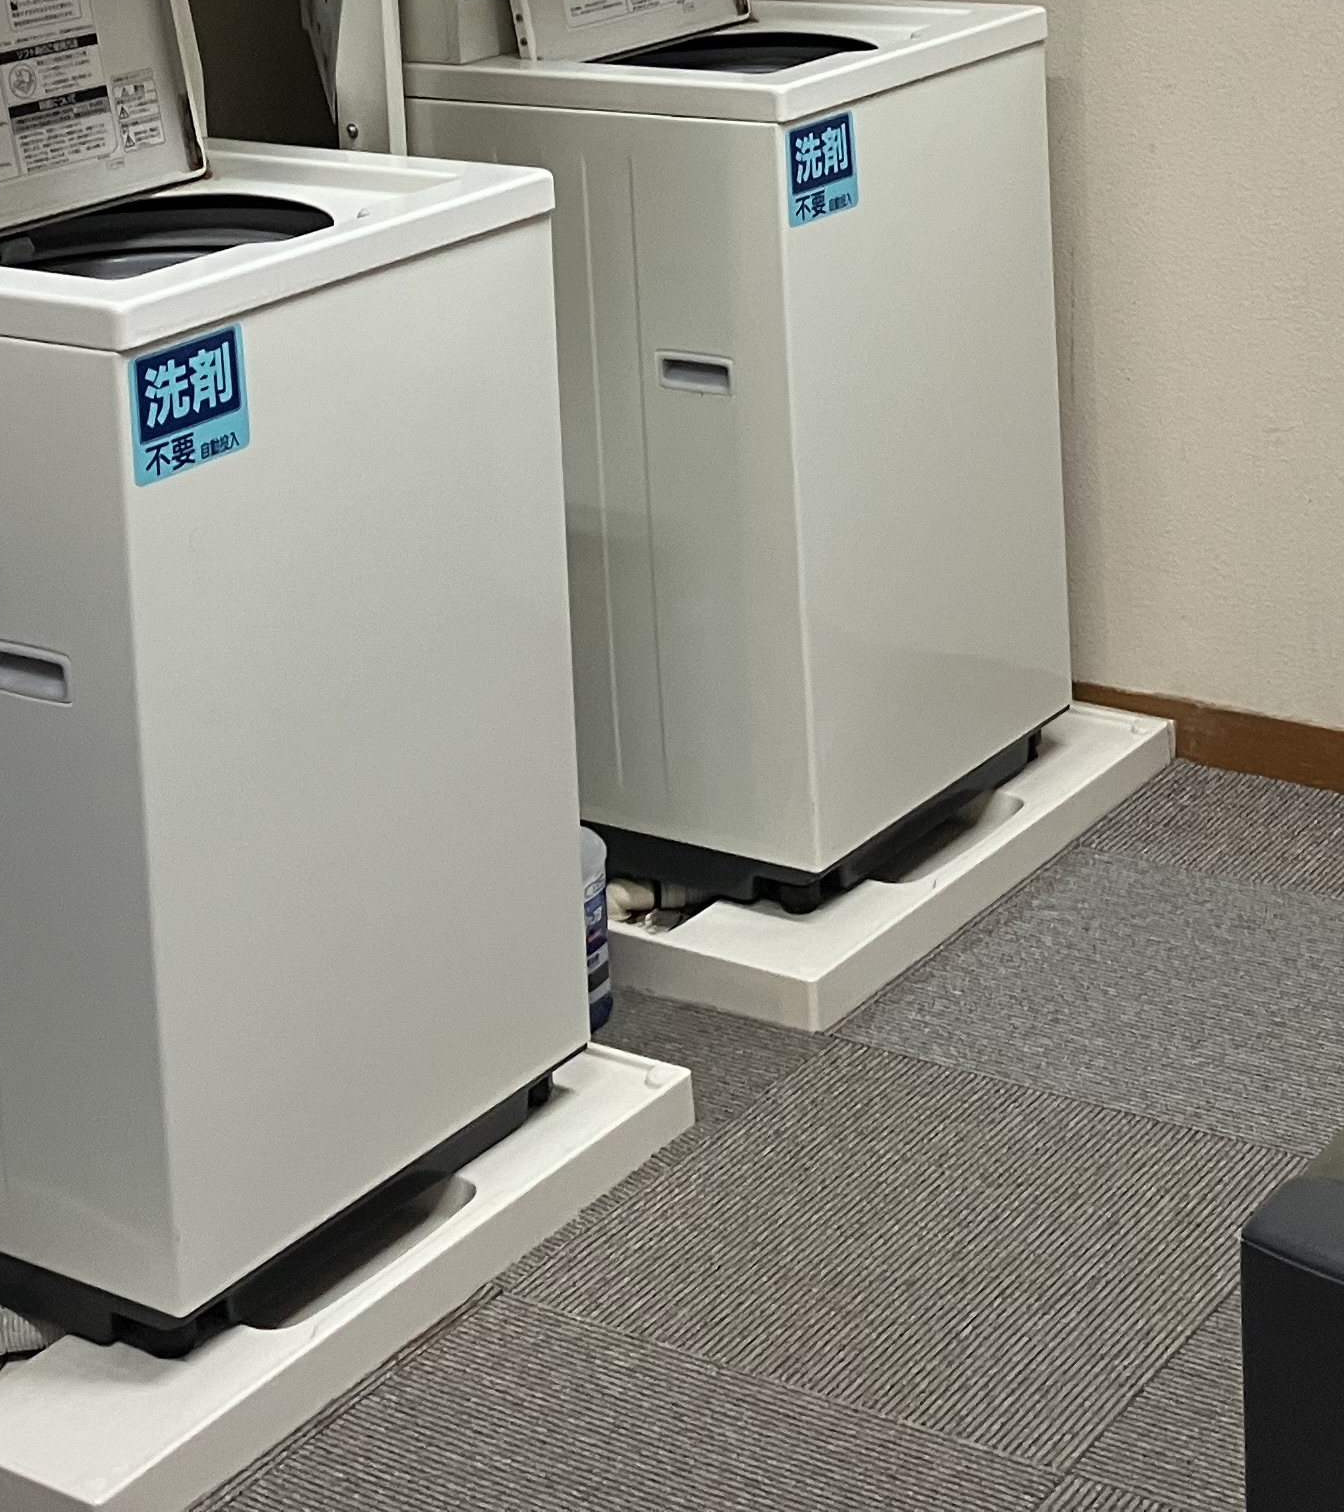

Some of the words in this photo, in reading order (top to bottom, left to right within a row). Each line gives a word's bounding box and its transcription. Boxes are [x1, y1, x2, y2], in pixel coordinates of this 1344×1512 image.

[795, 123, 849, 184] 洗剤
[795, 190, 826, 222] 不要
[144, 341, 233, 429] 洗剤
[145, 432, 196, 476] 不要
